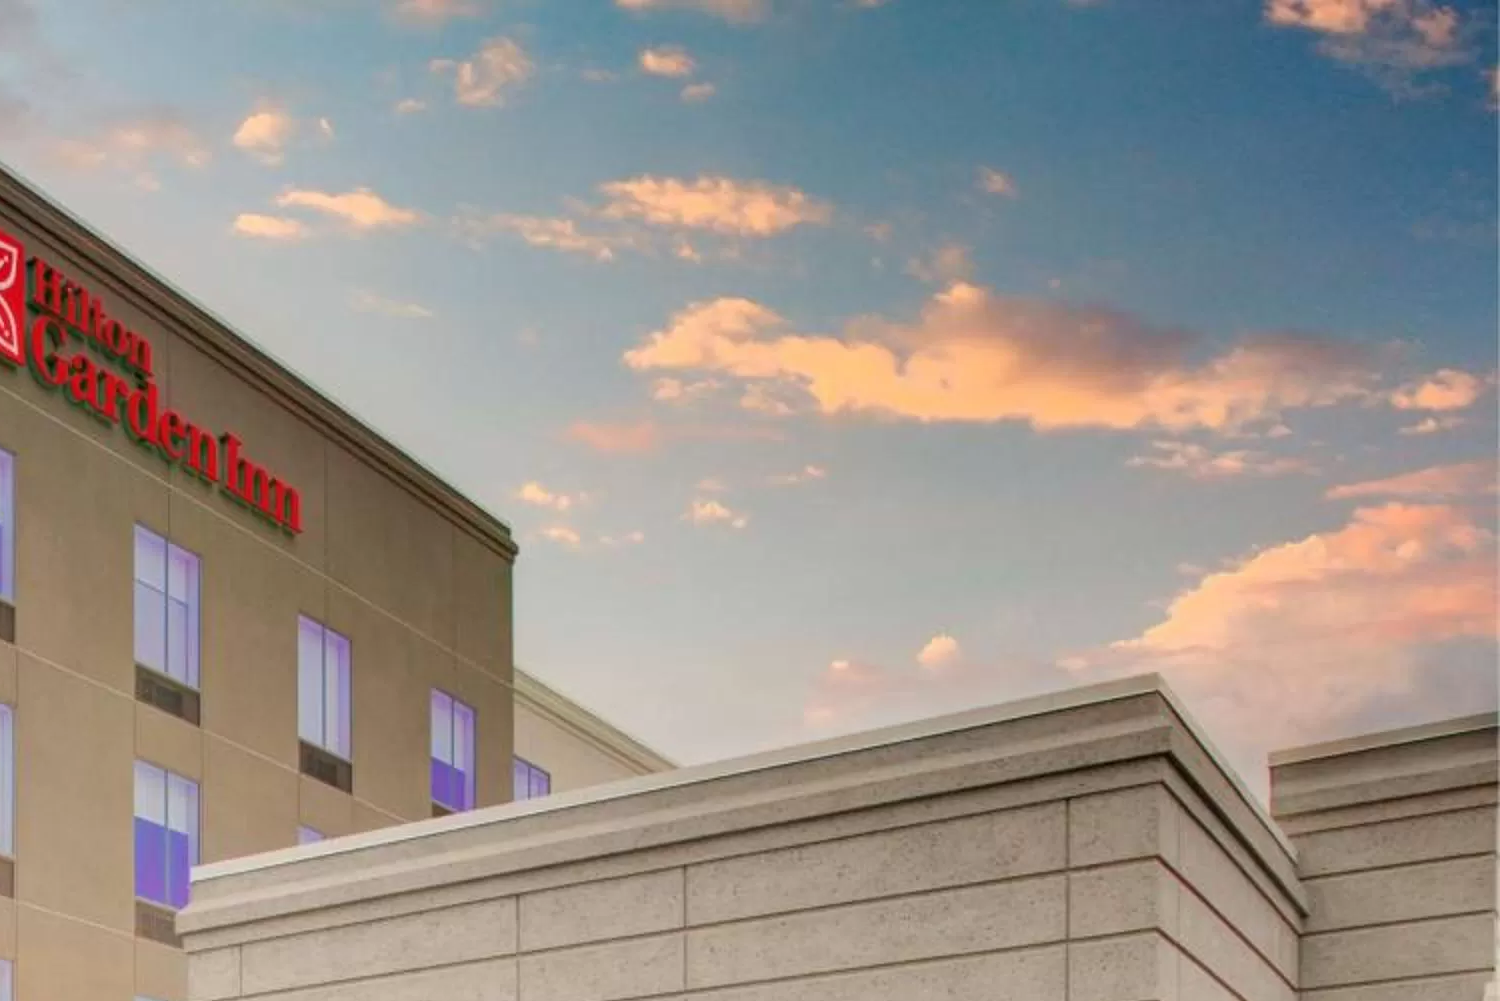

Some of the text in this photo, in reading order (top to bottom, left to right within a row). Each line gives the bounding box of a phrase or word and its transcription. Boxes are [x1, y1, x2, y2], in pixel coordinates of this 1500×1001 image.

[31, 257, 153, 376] Hilton
[29, 316, 303, 533] Garden Inn
